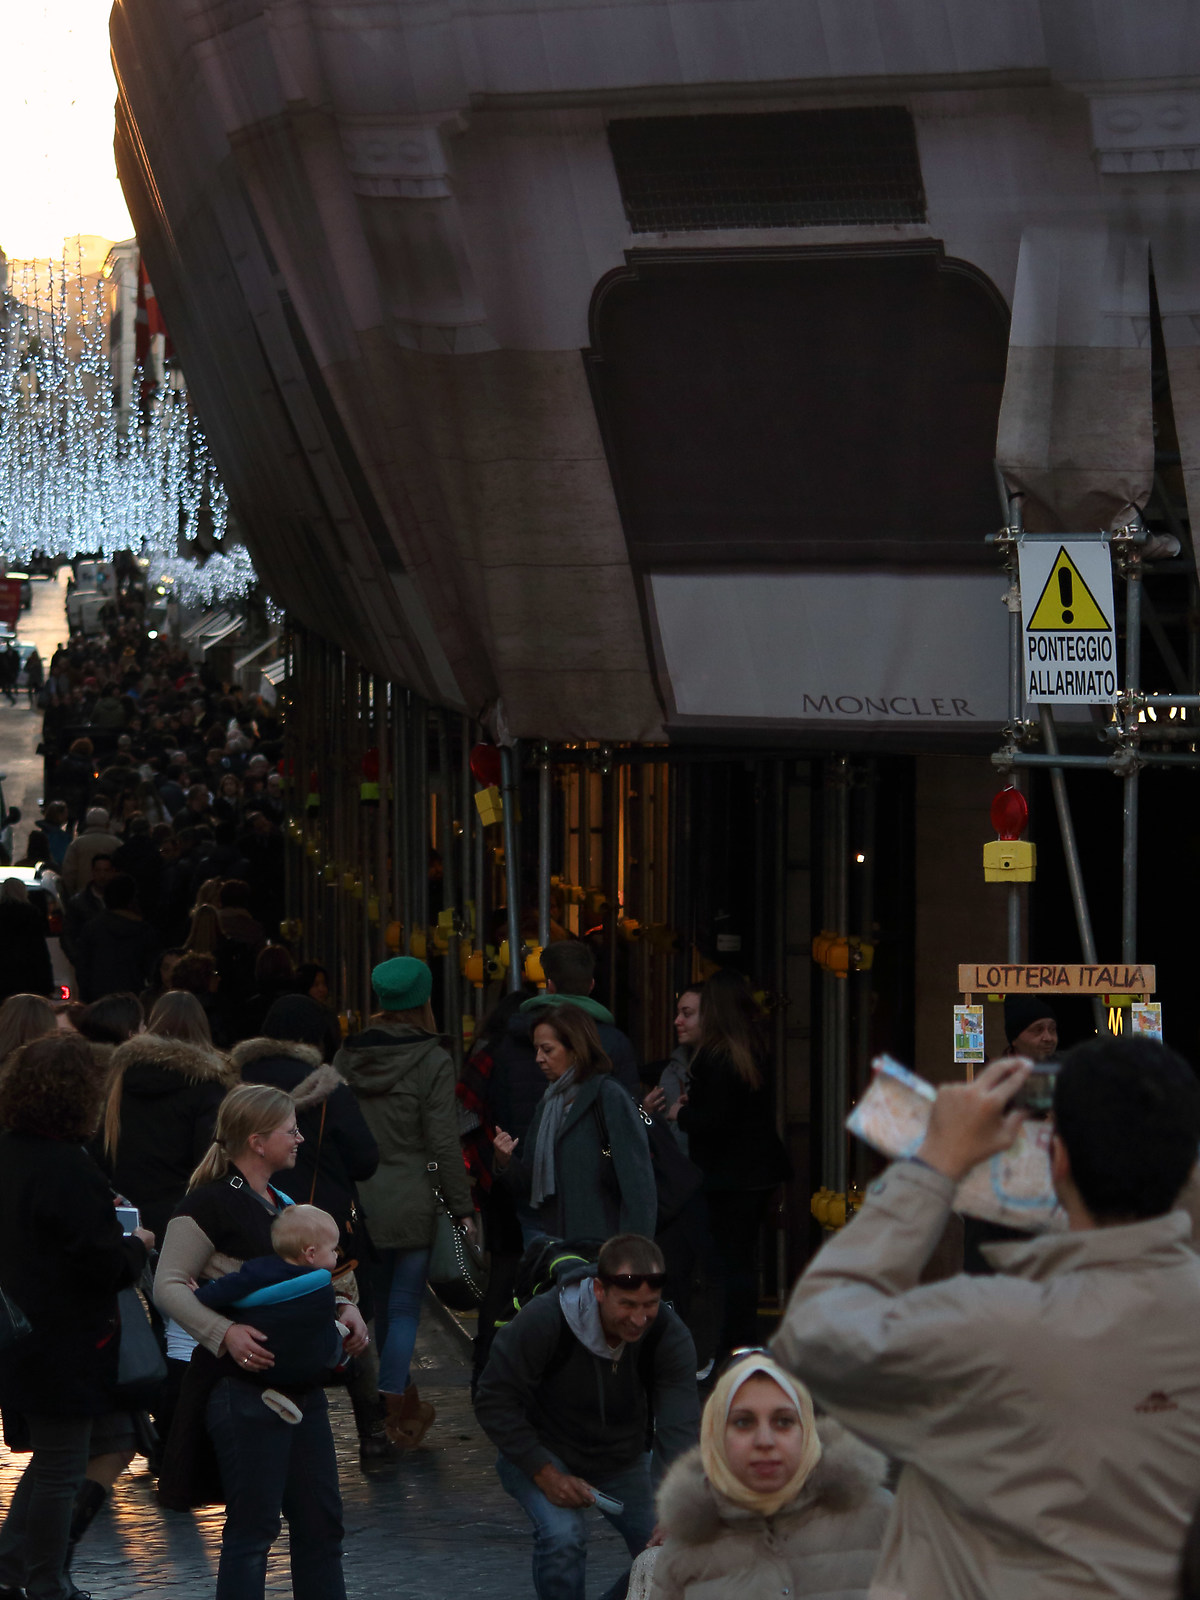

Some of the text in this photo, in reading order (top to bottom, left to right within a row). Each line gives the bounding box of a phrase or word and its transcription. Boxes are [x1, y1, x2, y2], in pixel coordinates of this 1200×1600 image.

[1028, 636, 1112, 662] PONTEGGIO
[1029, 670, 1115, 696] ALLARMATO
[802, 693, 976, 717] MONCLER
[975, 966, 1146, 989] LOTTERIA ITALIA
